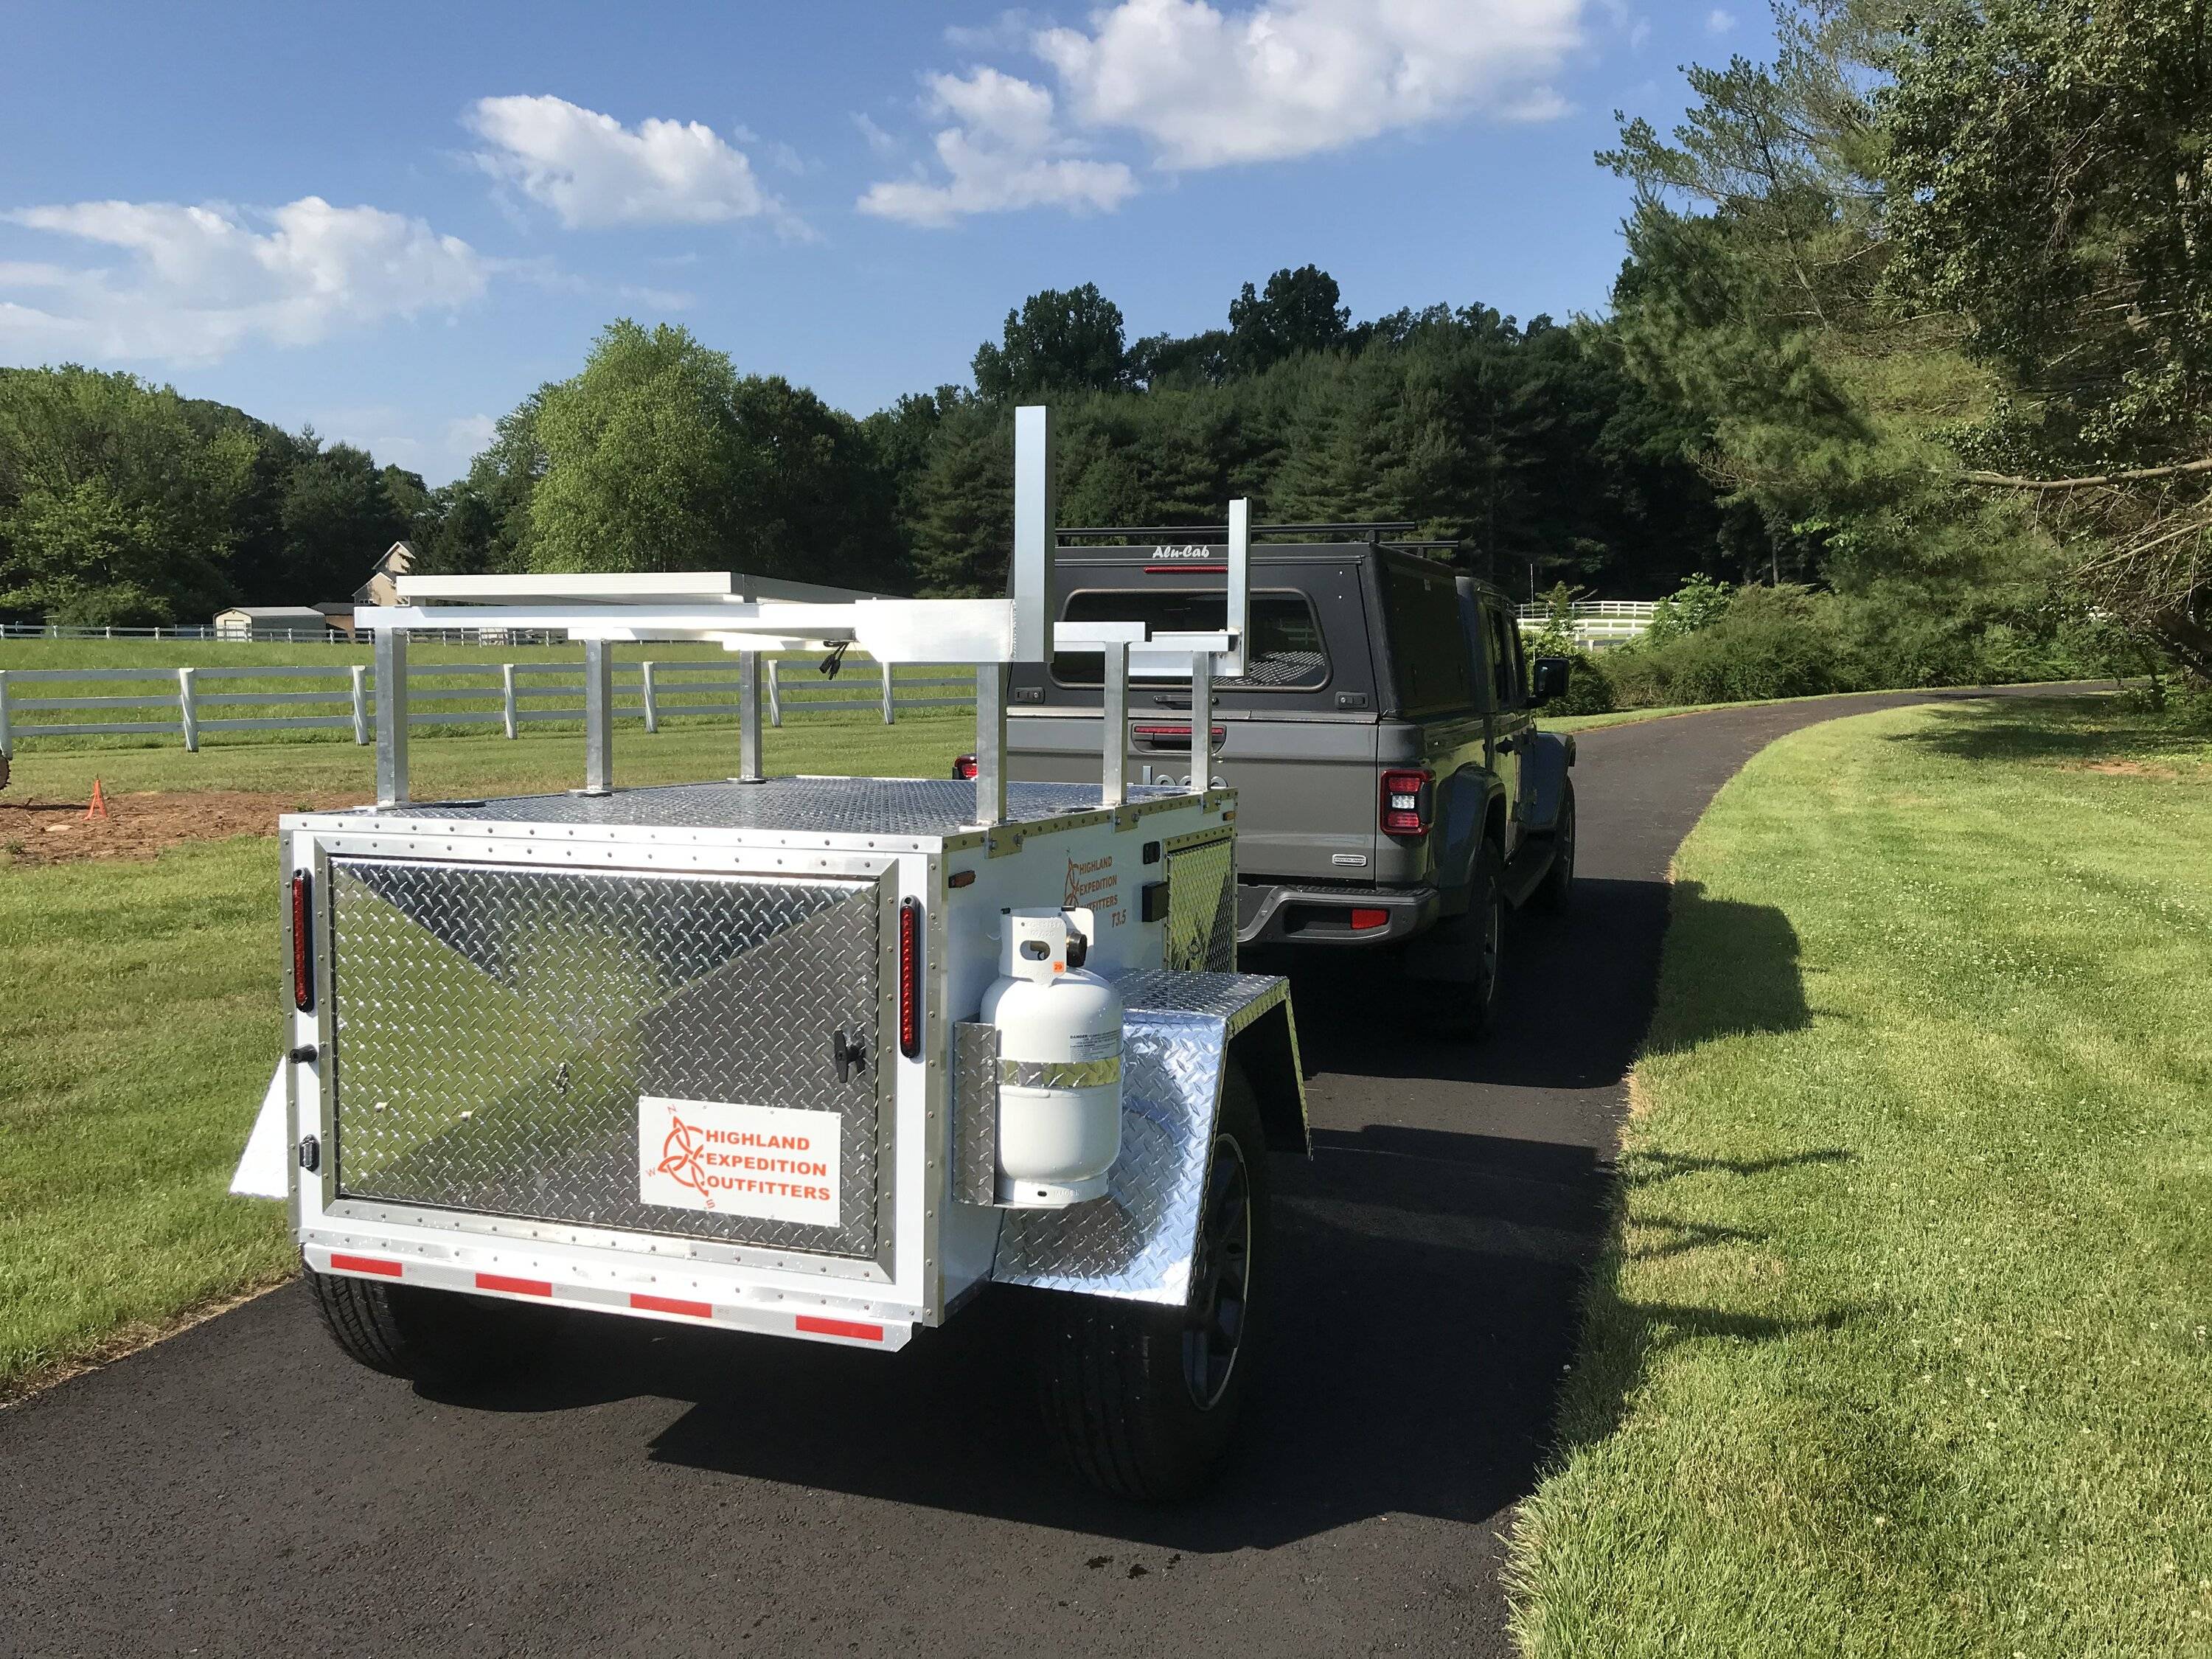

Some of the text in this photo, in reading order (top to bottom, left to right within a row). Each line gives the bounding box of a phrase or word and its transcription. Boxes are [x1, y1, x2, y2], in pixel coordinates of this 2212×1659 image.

[1152, 545, 1210, 558] Alu-Cab
[1079, 856, 1113, 875] HIGHLAND
[1079, 874, 1118, 897] EXPEDITION
[1111, 909, 1127, 928] T3.5
[706, 1130, 810, 1151] HIGHLAND
[706, 1152, 827, 1177] EXPEDITION
[707, 1175, 830, 1201] OUTFITTERS
